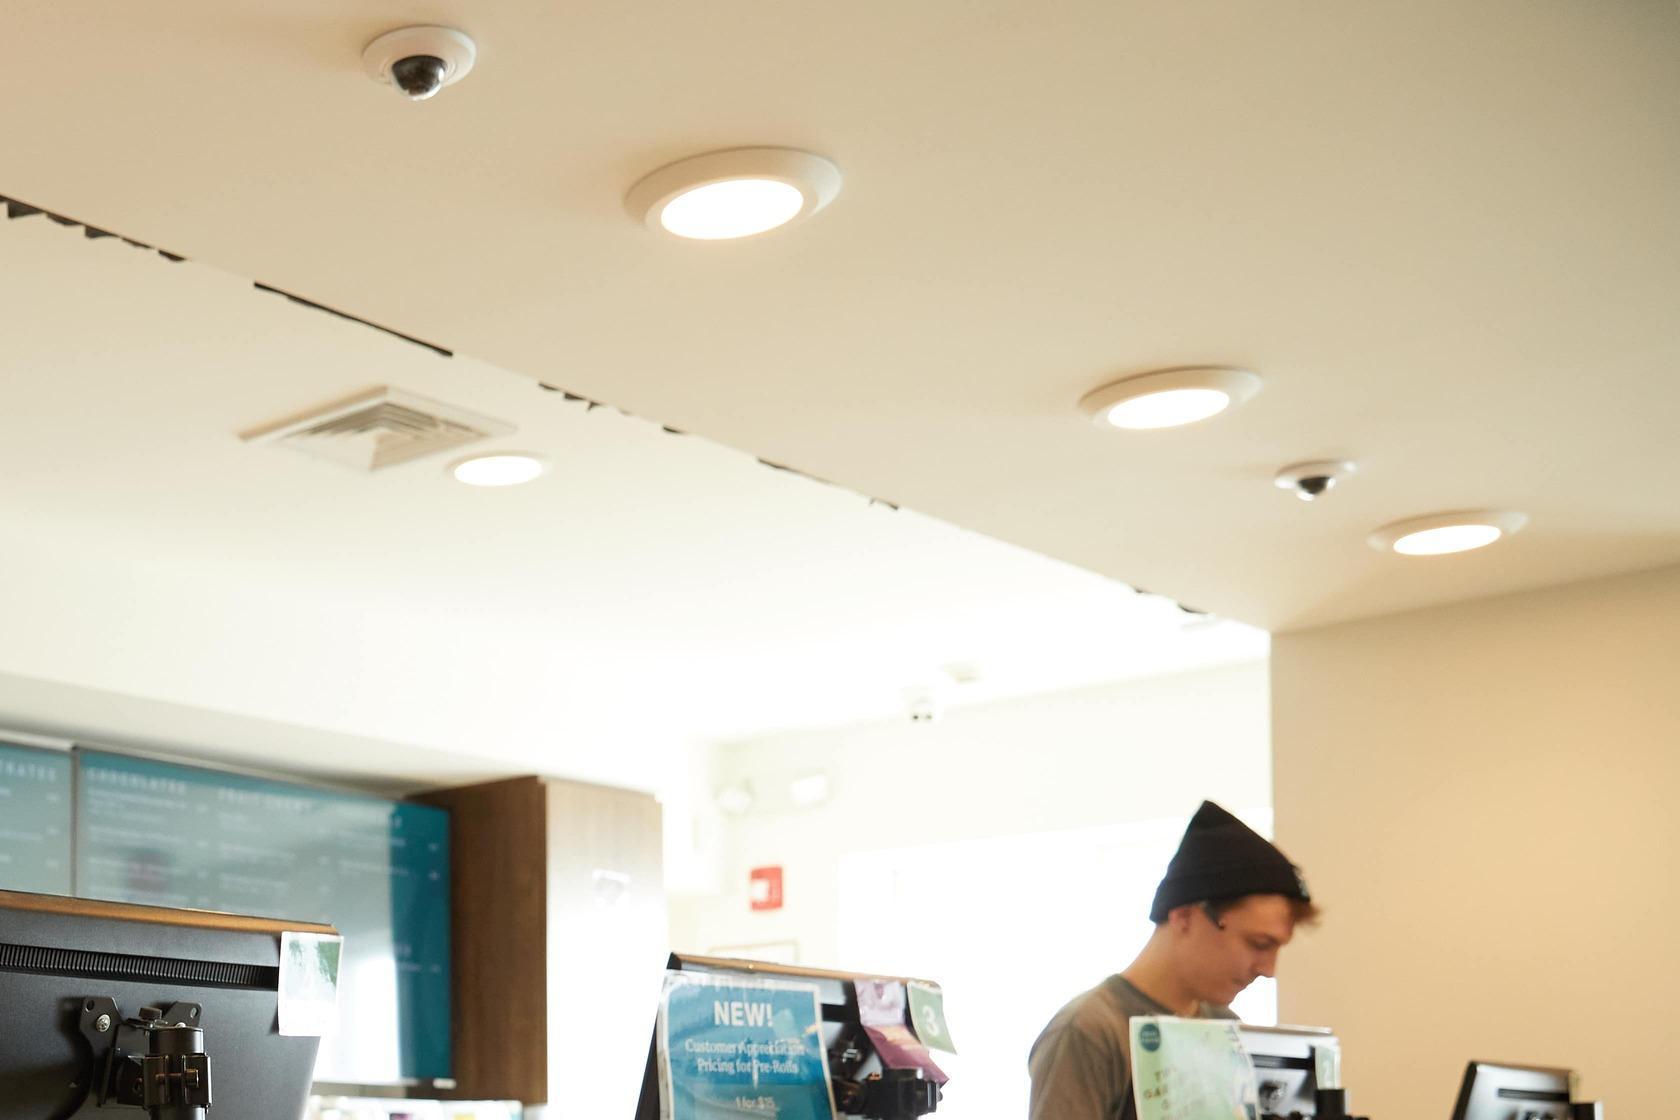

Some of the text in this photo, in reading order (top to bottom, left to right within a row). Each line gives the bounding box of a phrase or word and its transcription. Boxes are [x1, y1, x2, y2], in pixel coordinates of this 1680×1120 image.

[713, 1000, 774, 1027] NEW!
[922, 1005, 940, 1035] 3
[685, 1038, 737, 1054] Customer
[697, 1057, 735, 1074] Pricing
